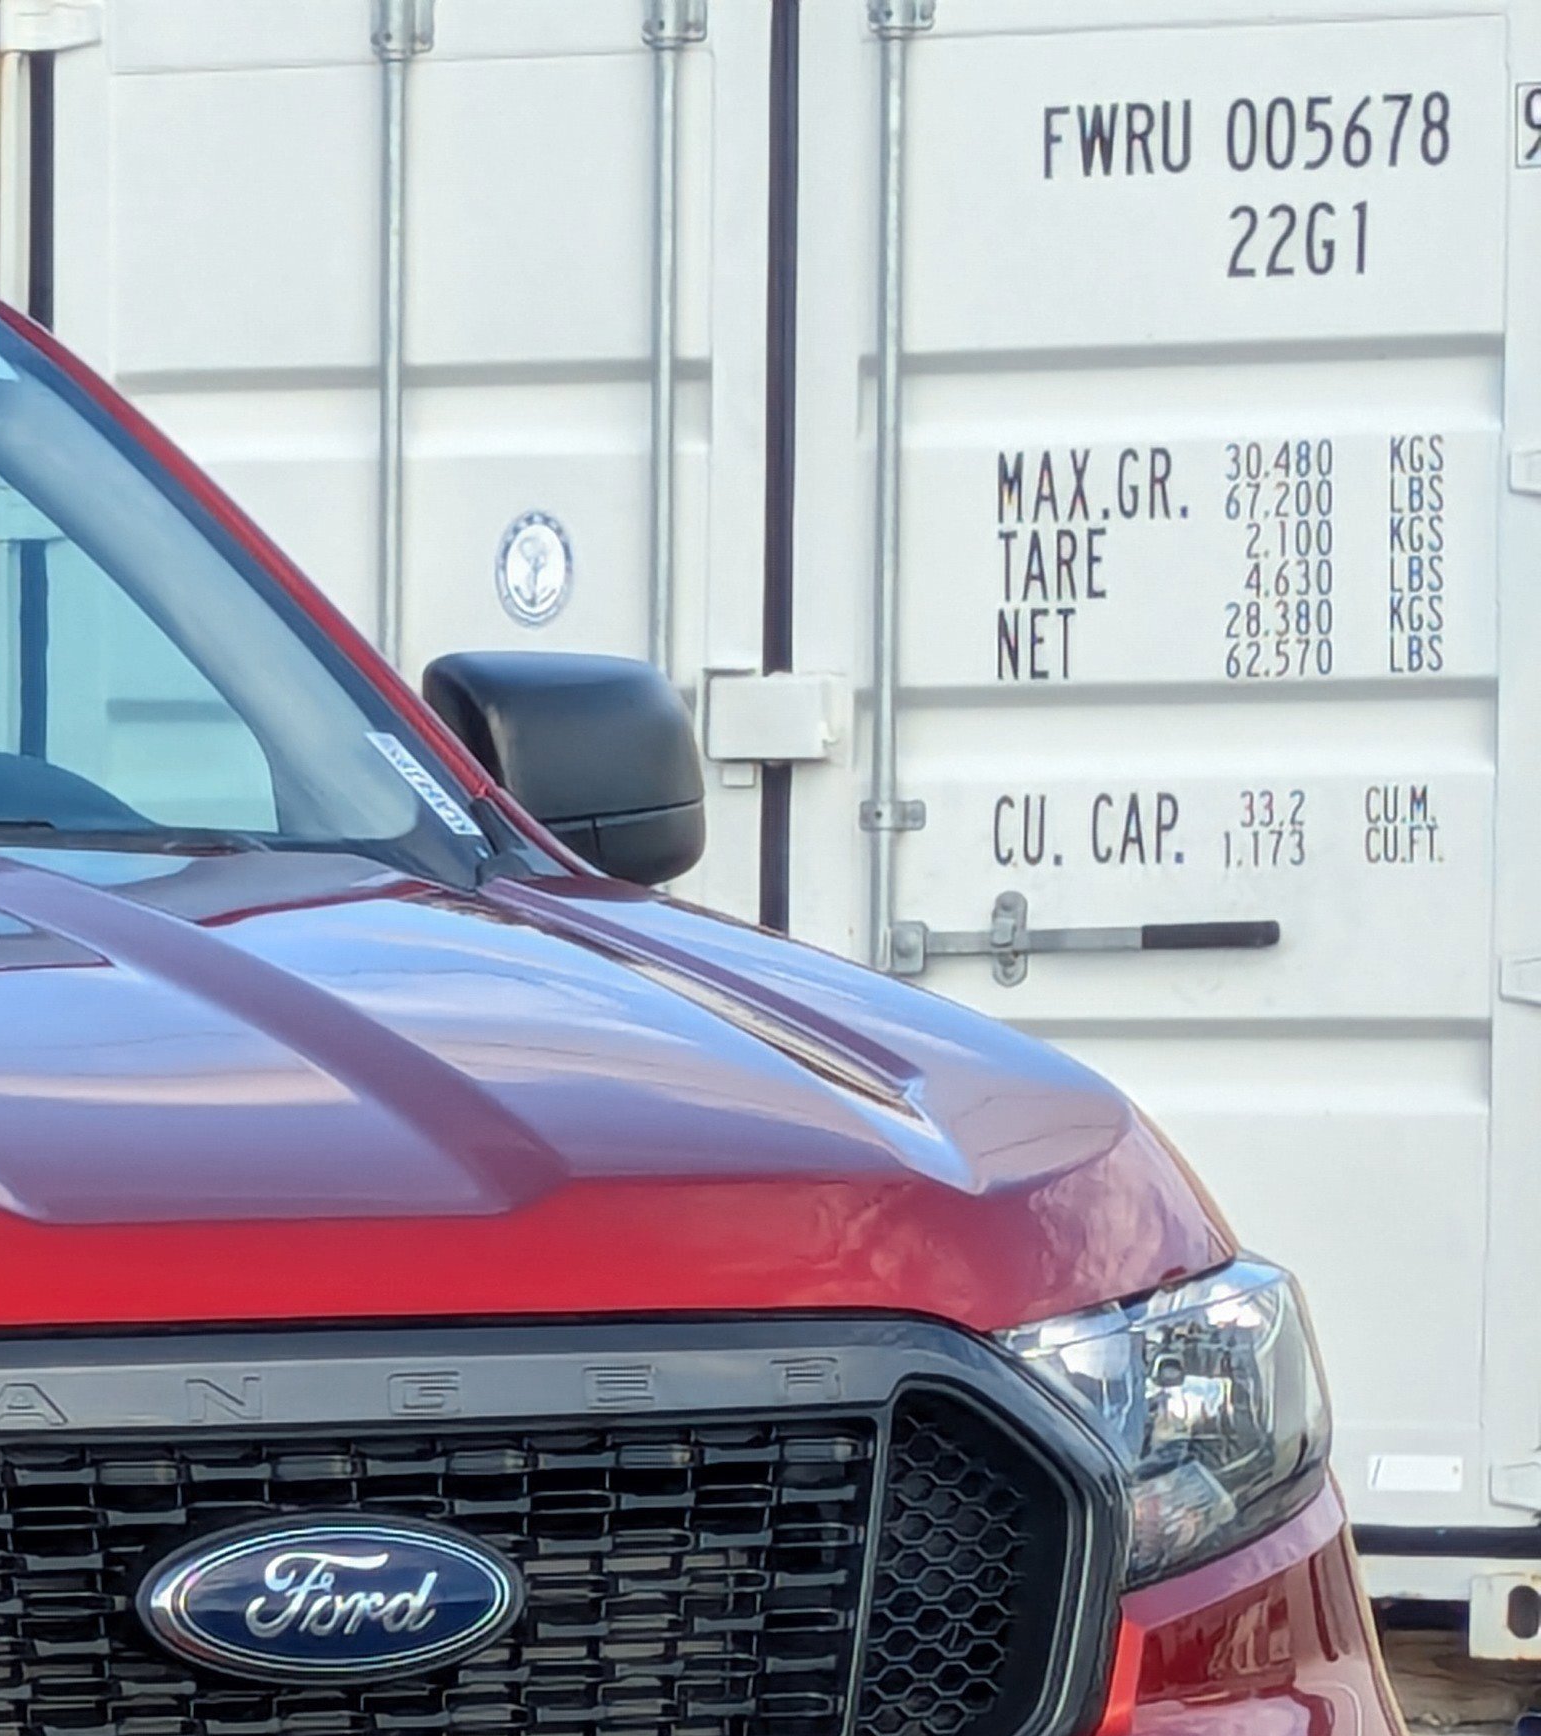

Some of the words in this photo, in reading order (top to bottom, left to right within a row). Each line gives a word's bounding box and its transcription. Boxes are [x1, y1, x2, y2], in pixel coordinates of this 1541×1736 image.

[1043, 98, 1192, 180] FWRU
[1226, 90, 1450, 172] 005678
[1227, 200, 1368, 278] 22G1
[997, 447, 1189, 524] MAX.GR.
[1225, 438, 1333, 481] 30.480
[1389, 434, 1444, 474] KGS
[1225, 479, 1333, 520] 67.200
[1389, 474, 1444, 513] LBS
[997, 526, 1107, 603] TARE
[1245, 519, 1333, 559] 2.100
[1389, 514, 1444, 553] KGS
[1244, 558, 1333, 599] 4.630
[1389, 554, 1444, 593] LBS
[997, 607, 1077, 681] NET
[1225, 598, 1333, 639] 28.380
[1389, 594, 1444, 633] KGS
[1225, 637, 1333, 679] 62.570
[1389, 634, 1444, 674] LBS
[993, 794, 1063, 867] CU.
[1091, 792, 1184, 865] CAP.
[1239, 788, 1306, 829] 33.2
[1223, 829, 1306, 869] 1.173
[245, 1551, 438, 1639] Ford
